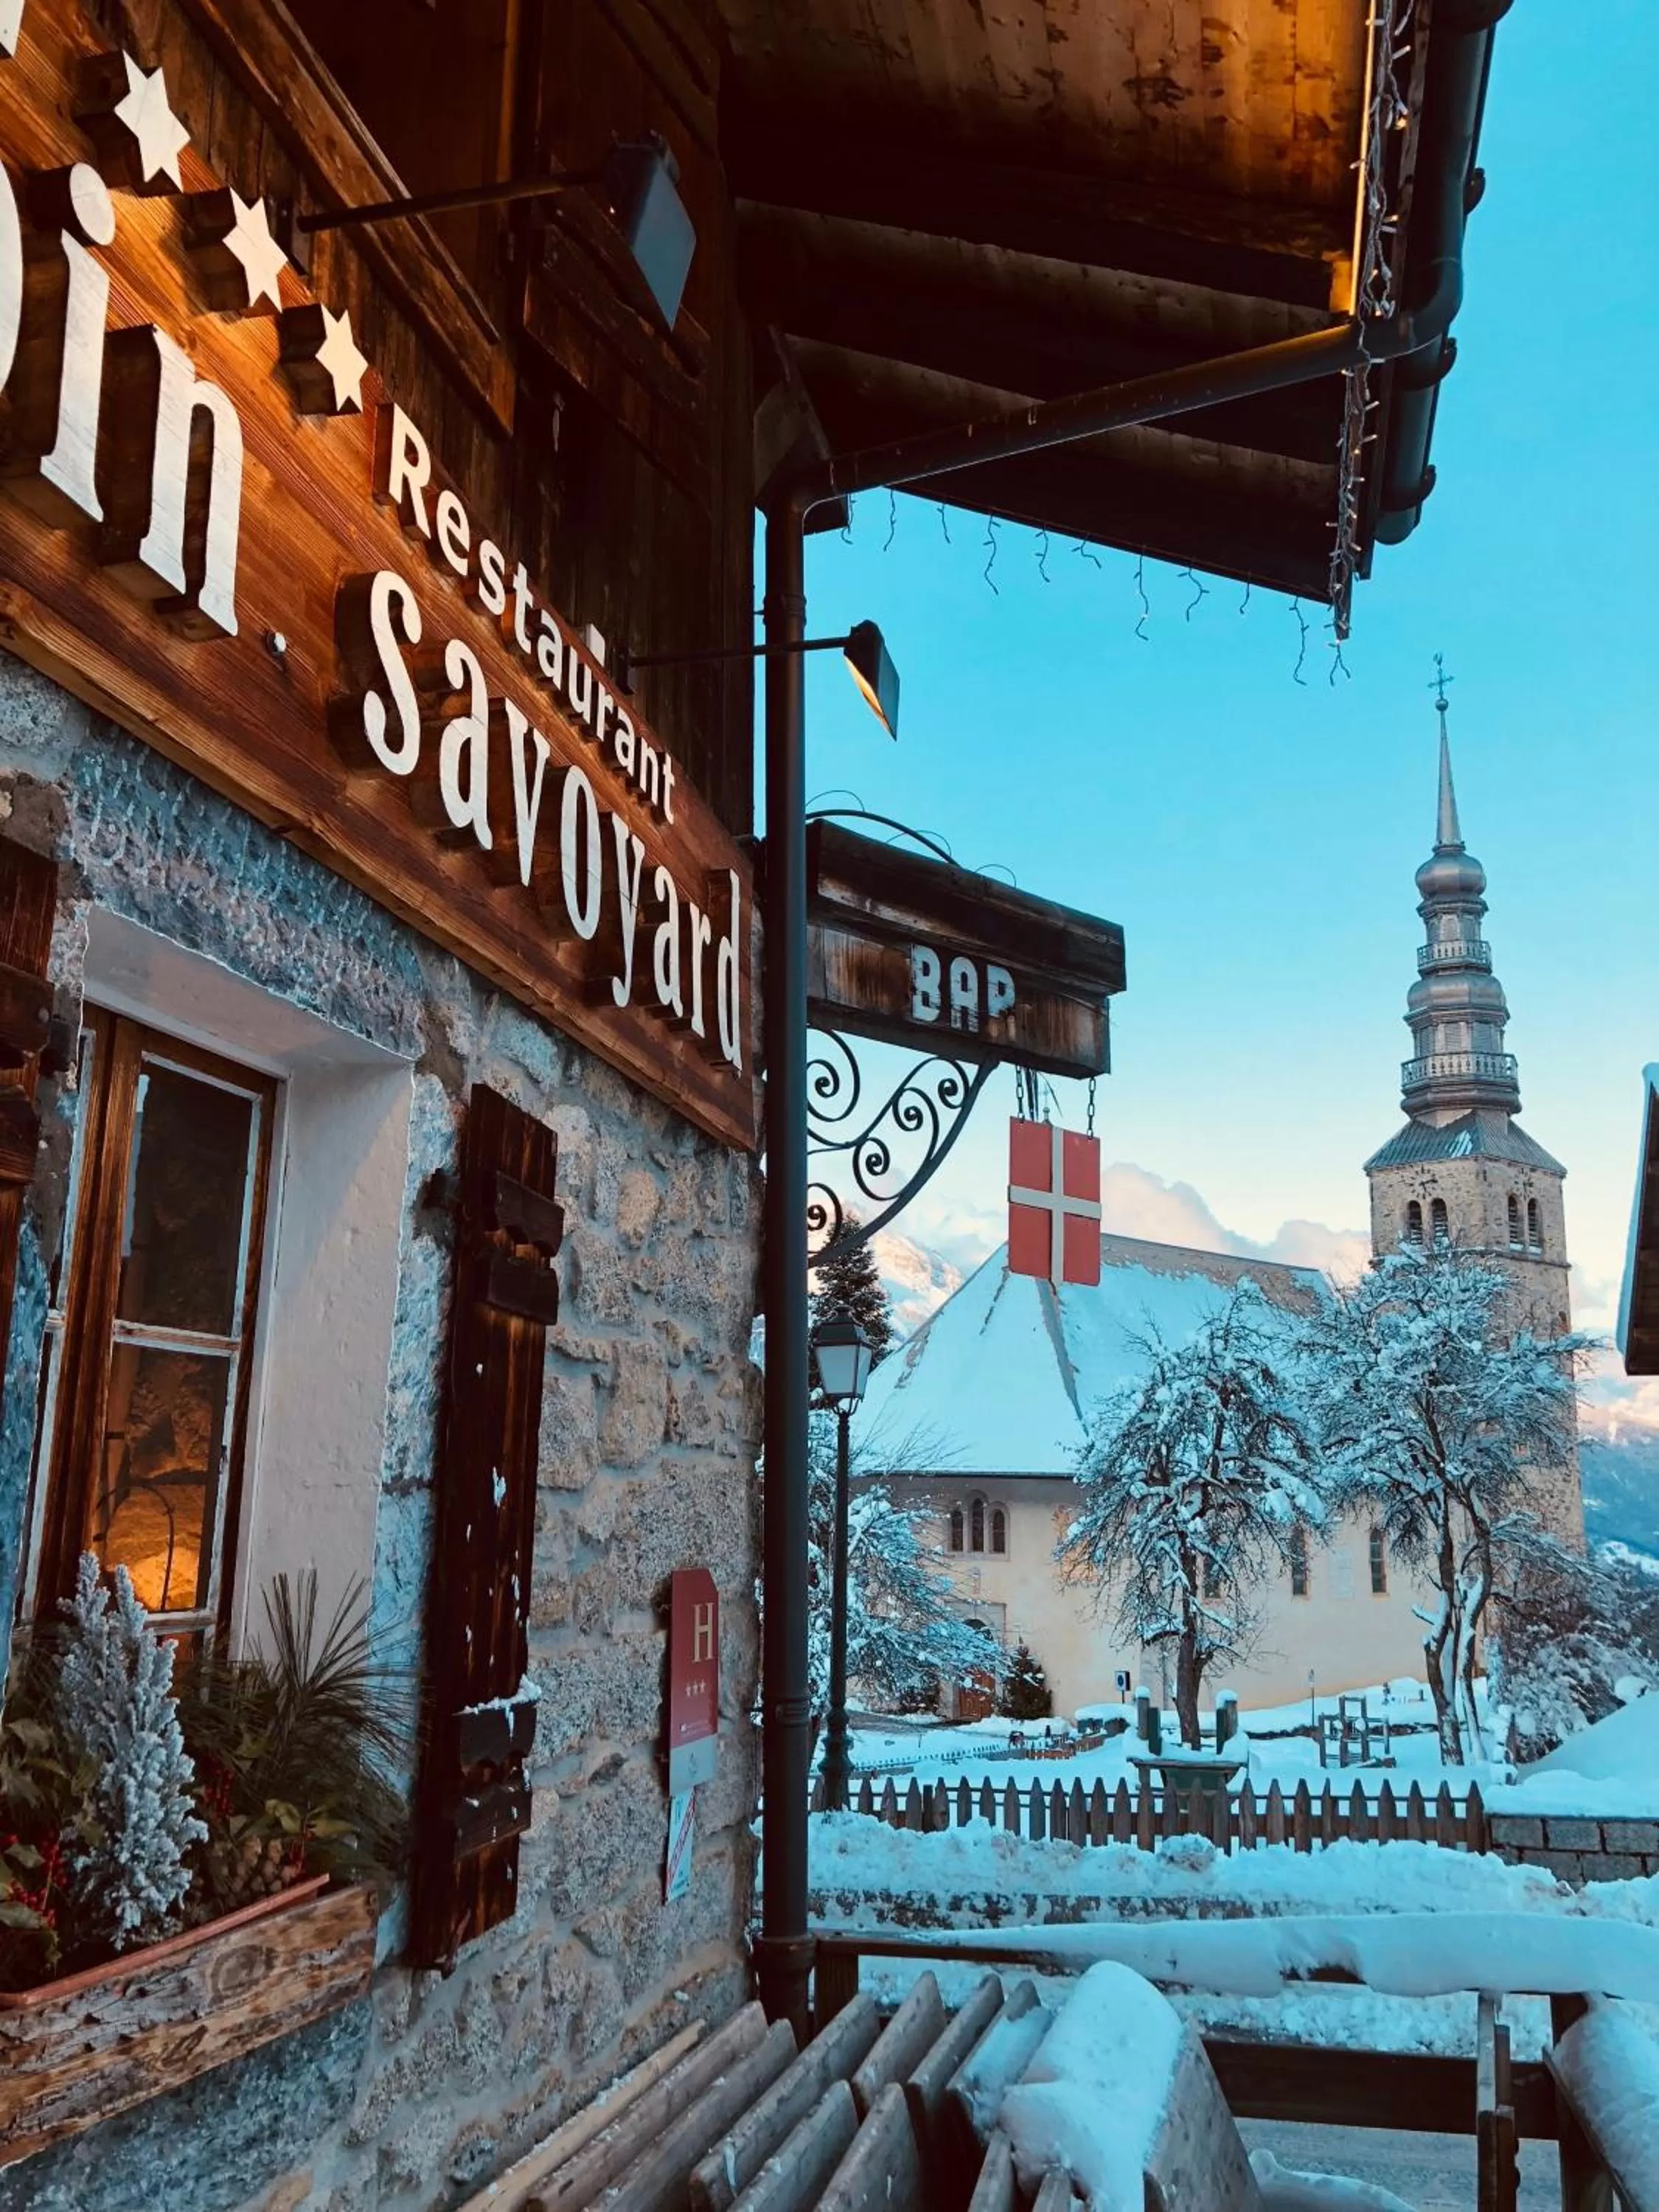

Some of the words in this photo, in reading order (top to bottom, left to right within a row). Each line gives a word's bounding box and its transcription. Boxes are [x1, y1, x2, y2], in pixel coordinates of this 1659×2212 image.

[364, 571, 741, 1077] Savoyard
[389, 403, 674, 824] Restaurant
[692, 1602, 714, 1663] H
